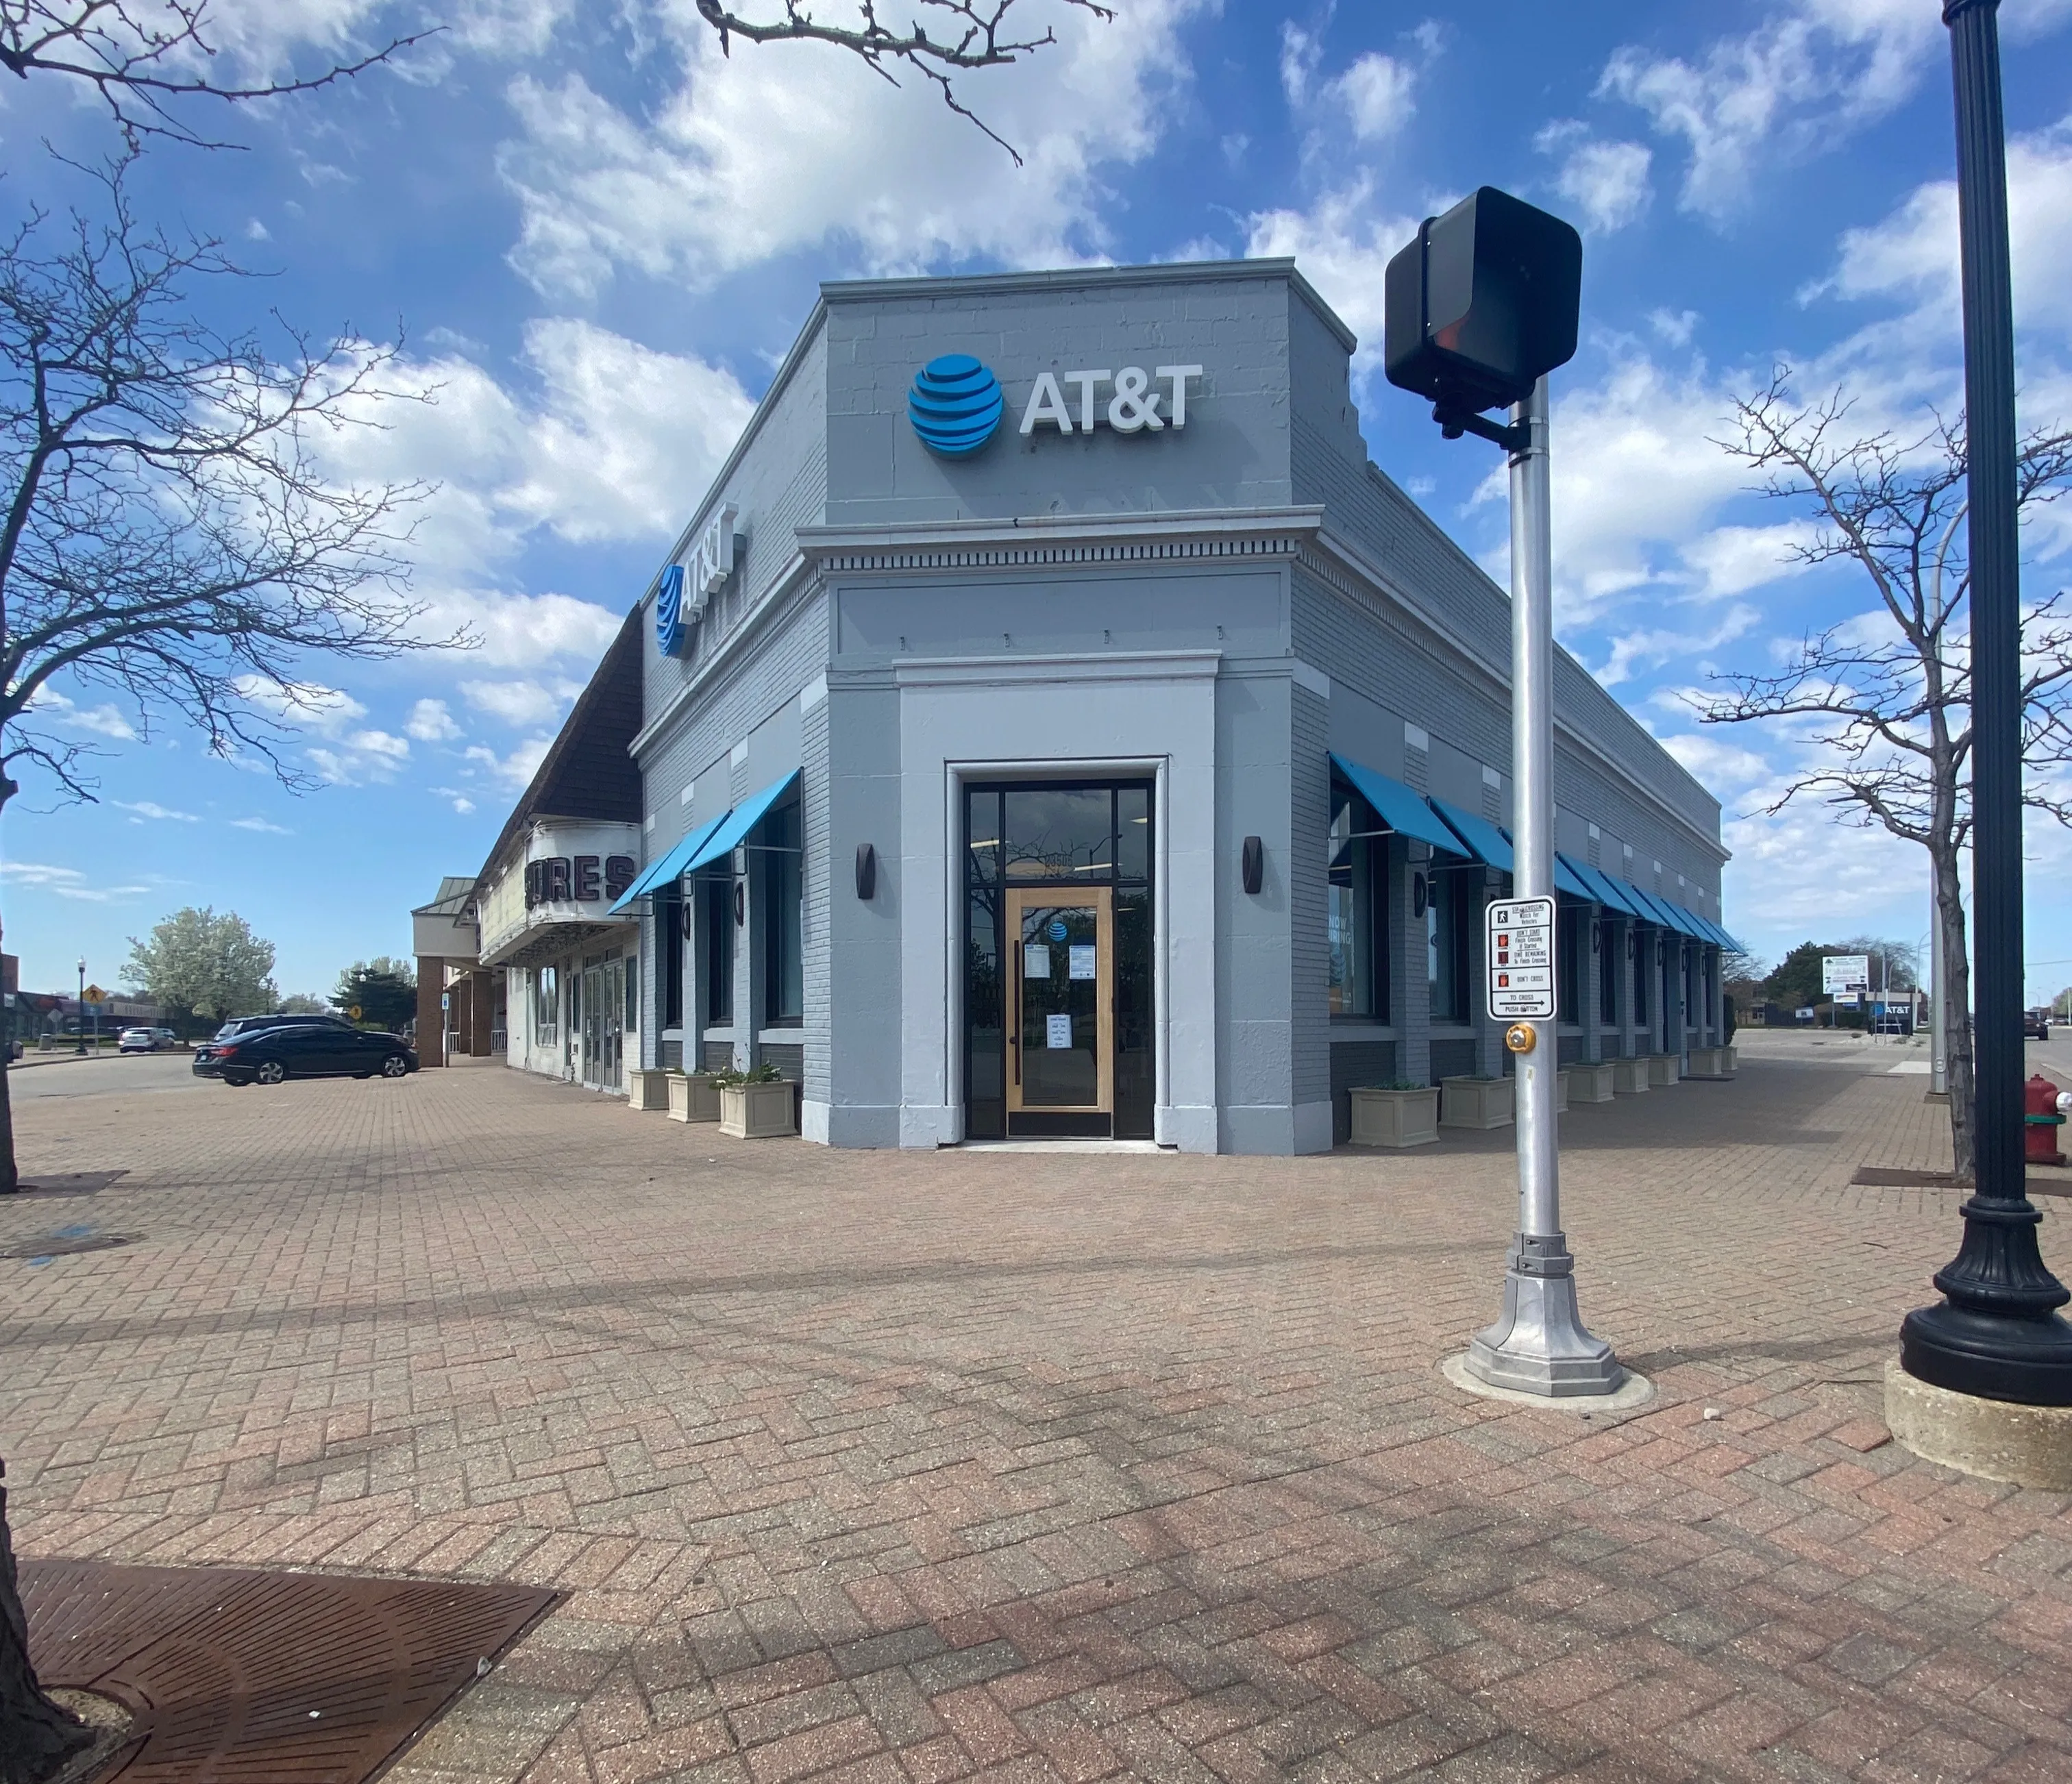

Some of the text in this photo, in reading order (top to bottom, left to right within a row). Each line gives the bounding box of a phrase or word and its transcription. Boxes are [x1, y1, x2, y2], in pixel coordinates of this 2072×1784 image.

[1019, 364, 1204, 437] AT&T
[678, 501, 739, 625] AT&T
[1329, 915, 1347, 930] NOW
[1886, 1006, 1910, 1014] AT&T
